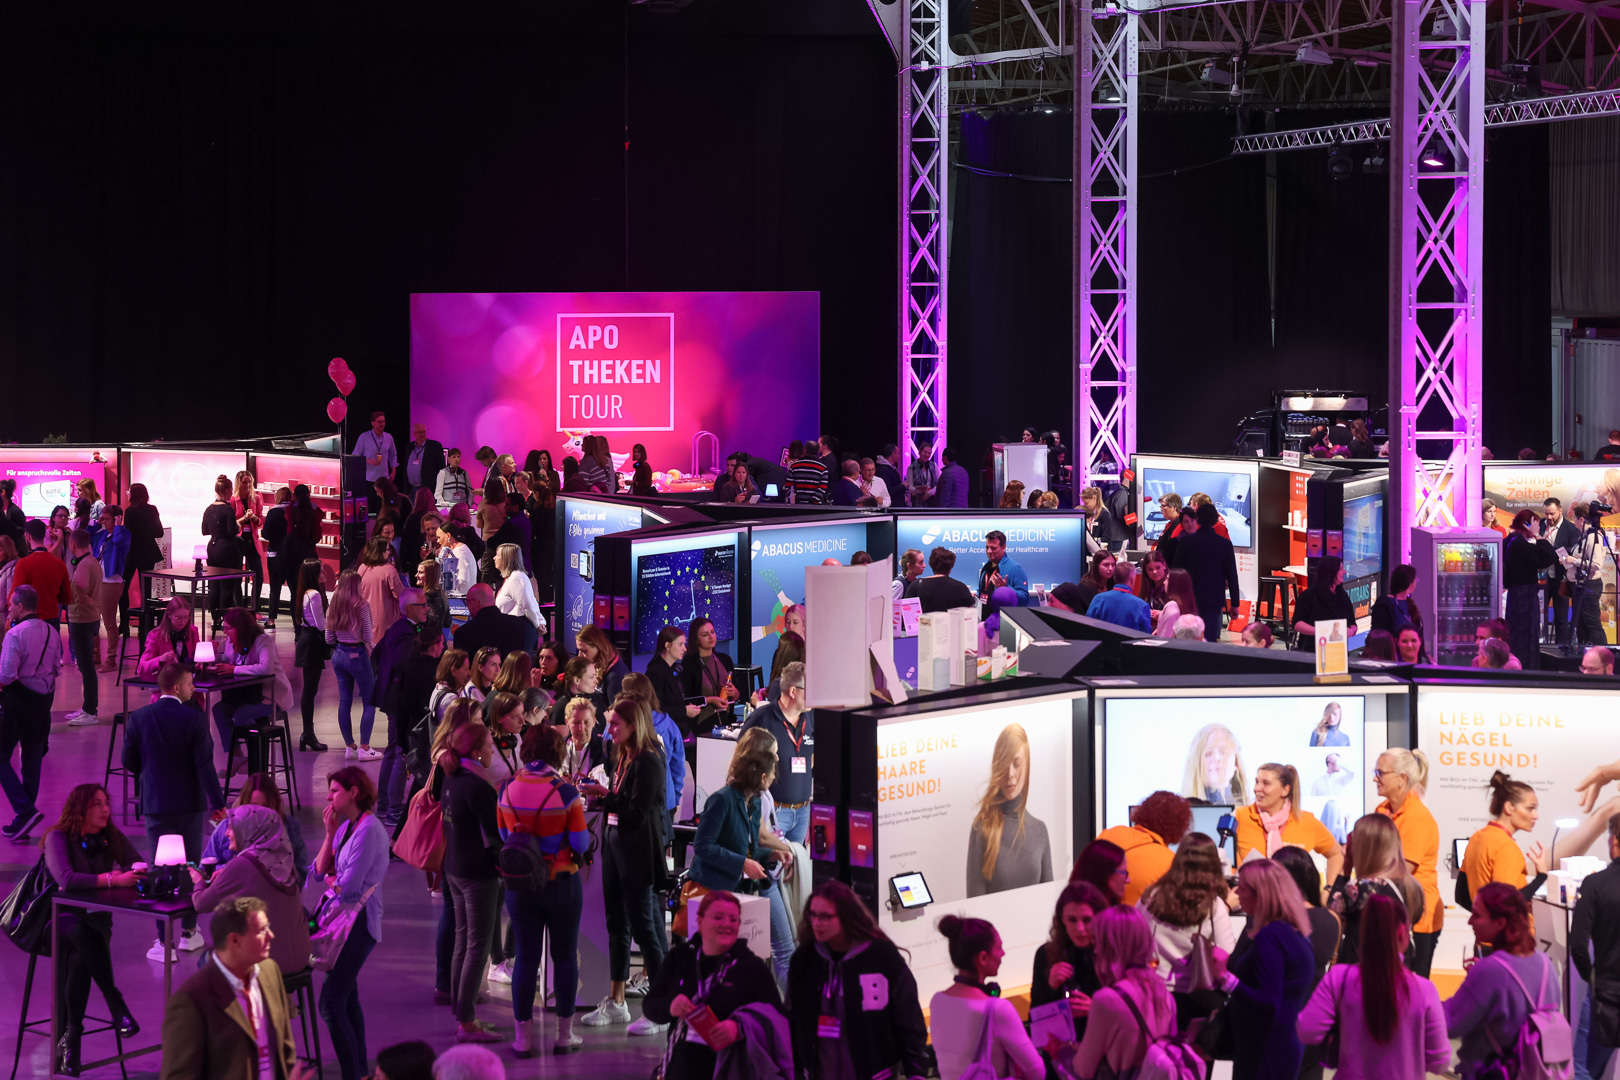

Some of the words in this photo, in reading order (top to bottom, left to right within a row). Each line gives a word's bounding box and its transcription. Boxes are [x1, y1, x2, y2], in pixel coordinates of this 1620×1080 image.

[569, 324, 619, 350] APO
[568, 359, 661, 384] THEKEN
[568, 394, 623, 419] TOUR
[17, 469, 61, 477] anspruchsvolle
[1507, 474, 1562, 487] Sonnige
[1506, 487, 1549, 499] Zeiten
[942, 529, 987, 542] ABACU
[762, 540, 803, 557] ABACUS
[804, 538, 848, 554] MEDICINE
[1439, 711, 1485, 726] LIEB
[1499, 712, 1565, 728] DEINE
[877, 741, 908, 759] LIEB
[916, 734, 958, 753] DEINE
[1439, 728, 1513, 747] NÄGEL
[1439, 751, 1538, 768] GESUND!
[877, 759, 926, 781] HAARE
[877, 777, 941, 802] GESUND!
[859, 973, 889, 1011] B
